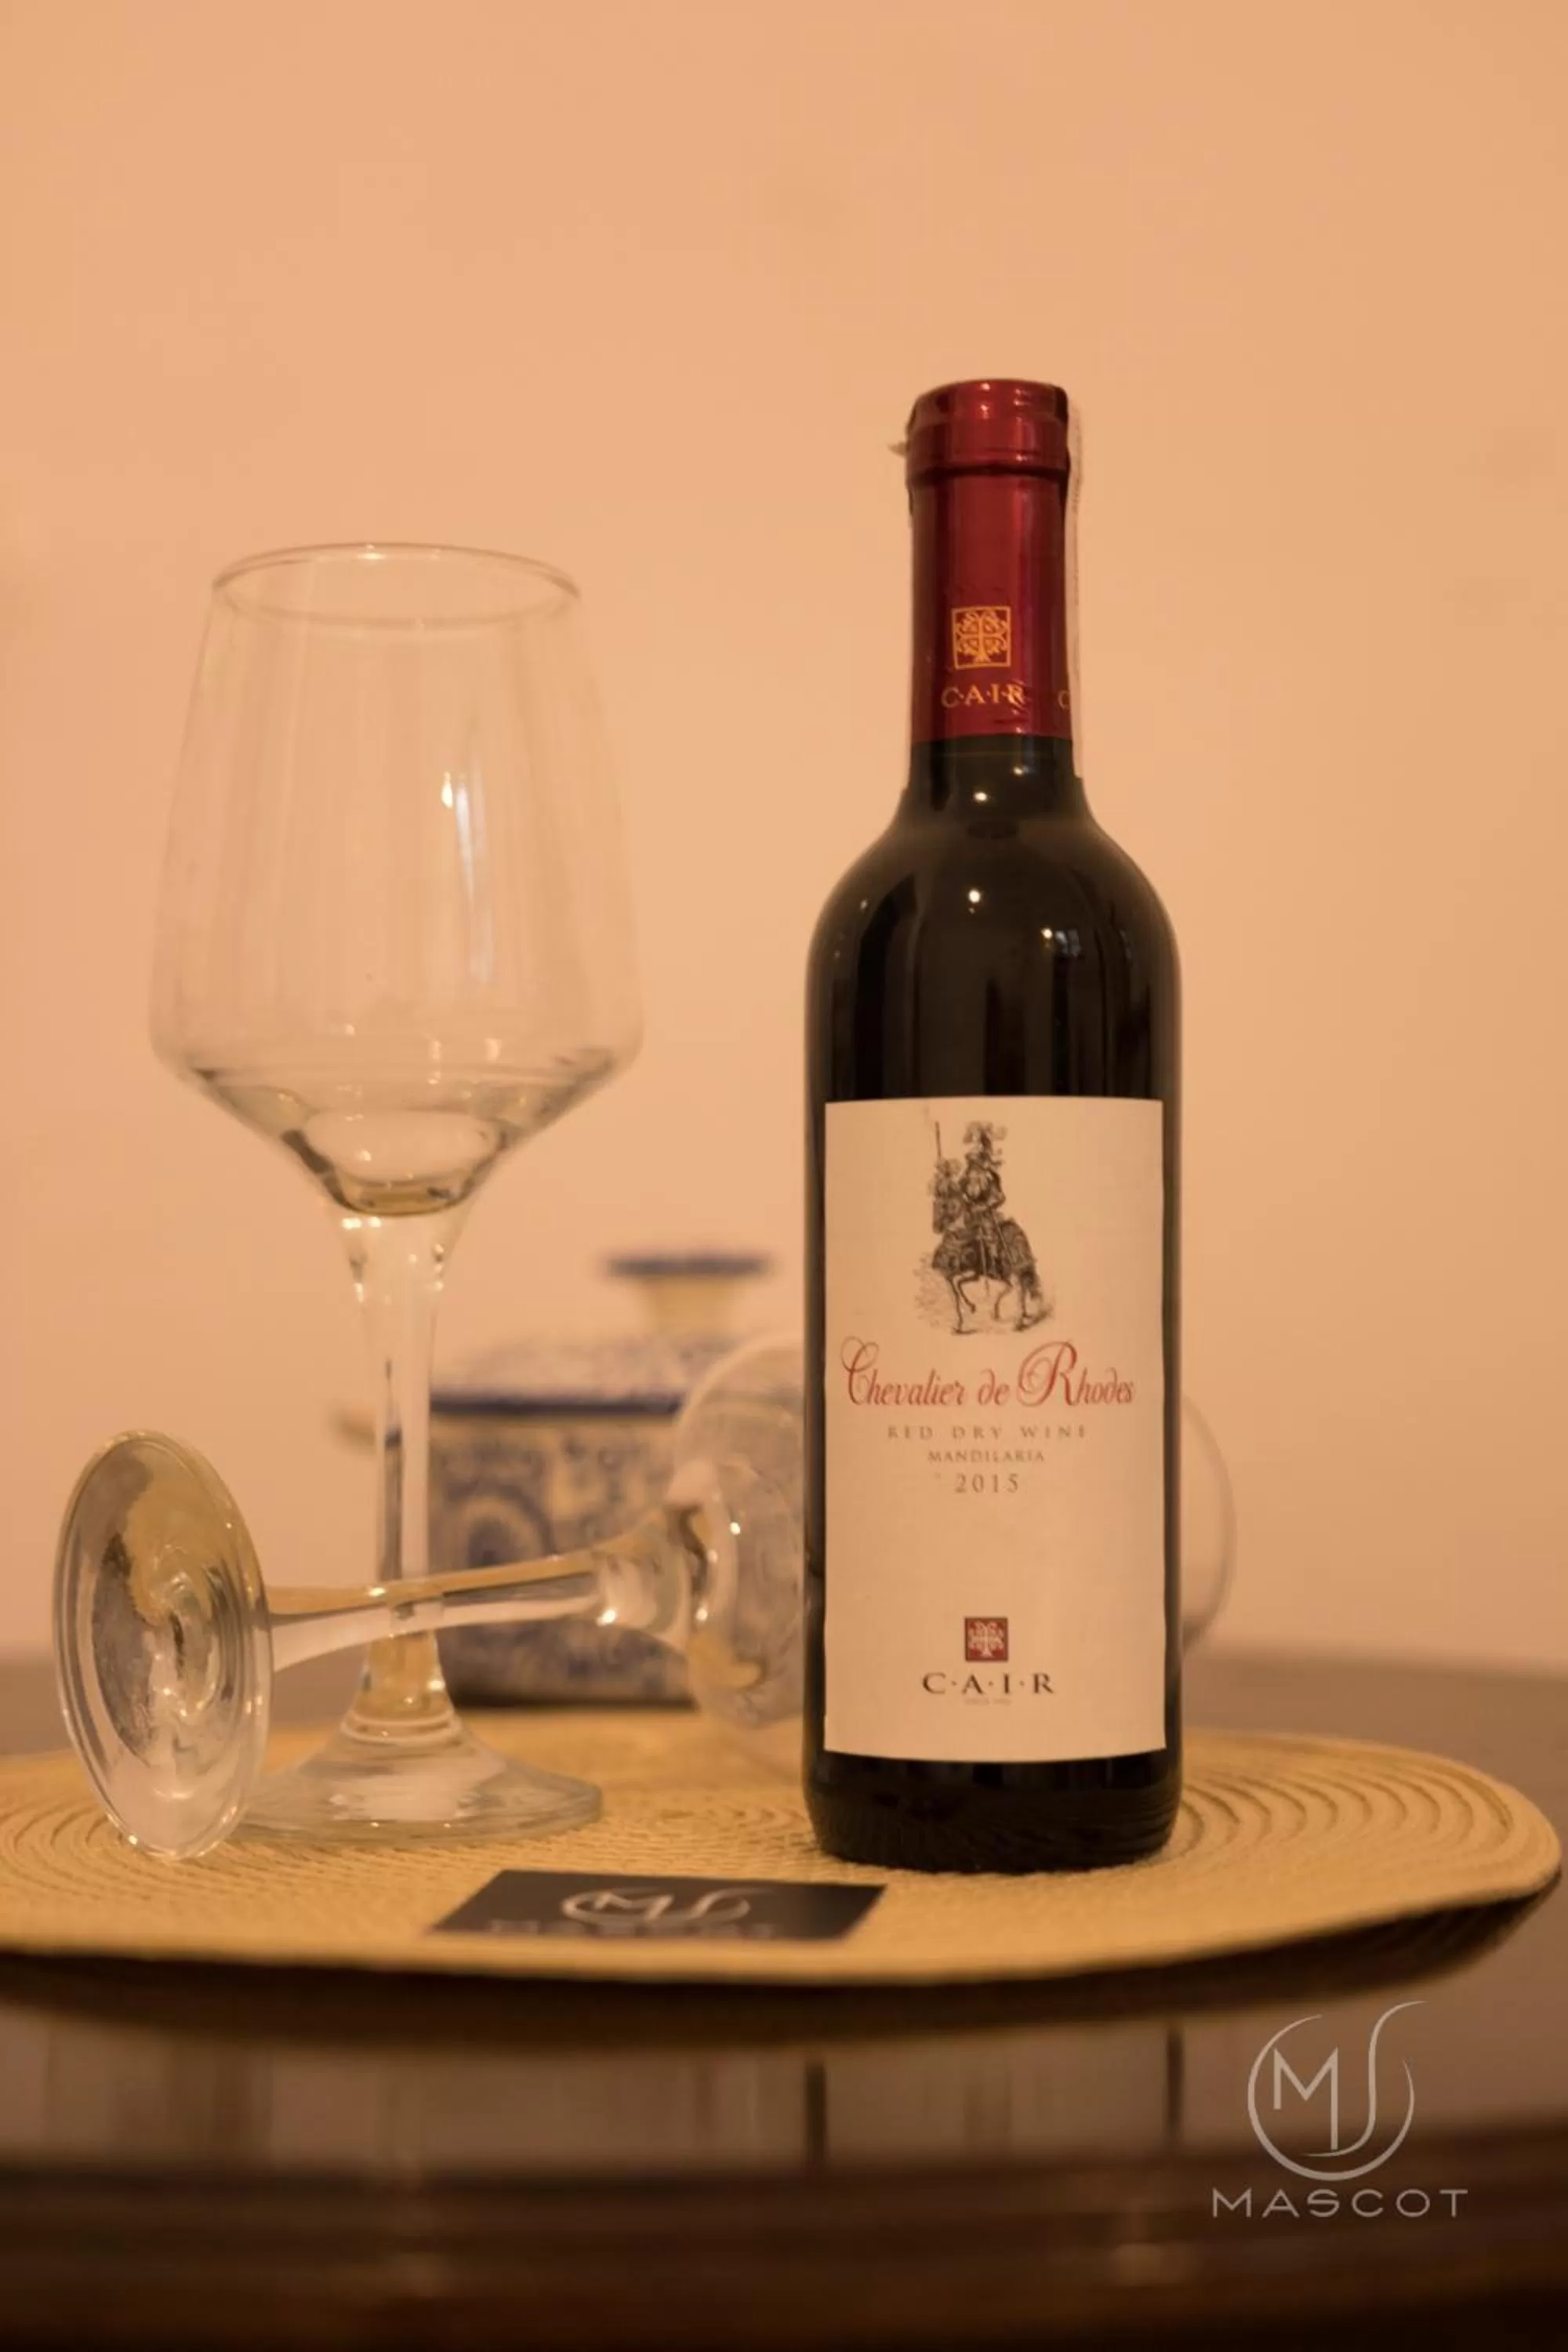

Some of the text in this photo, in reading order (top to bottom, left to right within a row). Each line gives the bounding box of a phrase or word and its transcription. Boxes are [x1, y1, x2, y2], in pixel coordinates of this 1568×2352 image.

[840, 1336, 1134, 1407] Chevalier de Rhodes
[953, 1425, 1002, 1439] DRY
[927, 1450, 1045, 1463] MANDILARIA
[955, 1473, 1018, 1493] 2015
